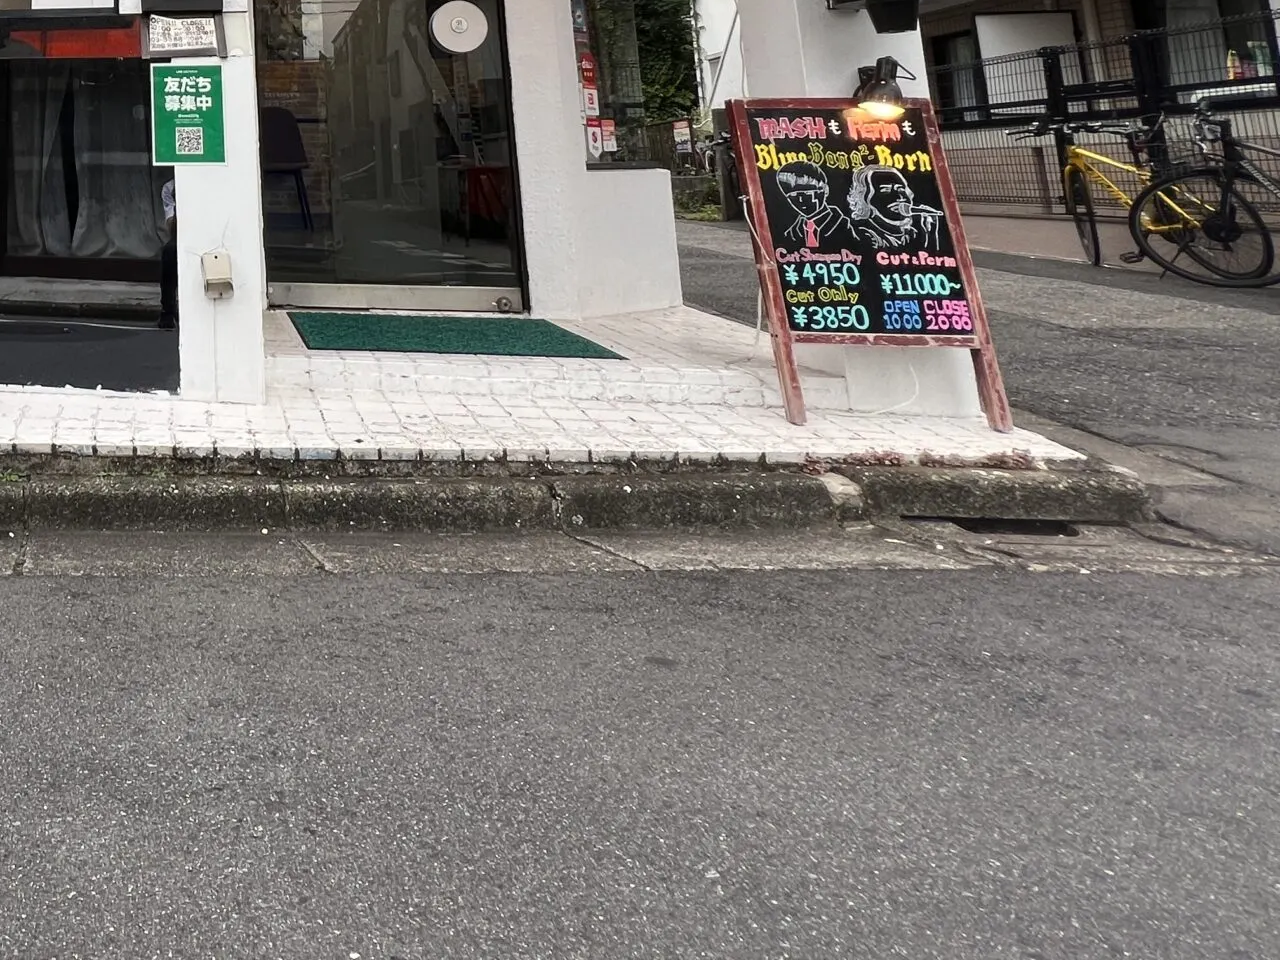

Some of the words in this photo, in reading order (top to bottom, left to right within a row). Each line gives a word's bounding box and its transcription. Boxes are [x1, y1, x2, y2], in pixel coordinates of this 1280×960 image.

[163, 76, 212, 93] 友だち
[164, 95, 212, 111] 募集中
[754, 117, 827, 140] MASH
[783, 263, 860, 285] ¥4950
[786, 289, 815, 303] Cut
[818, 285, 859, 304] Only
[791, 305, 870, 330] ¥3850
[884, 300, 920, 313] OPEN
[923, 300, 969, 317] CLOSE
